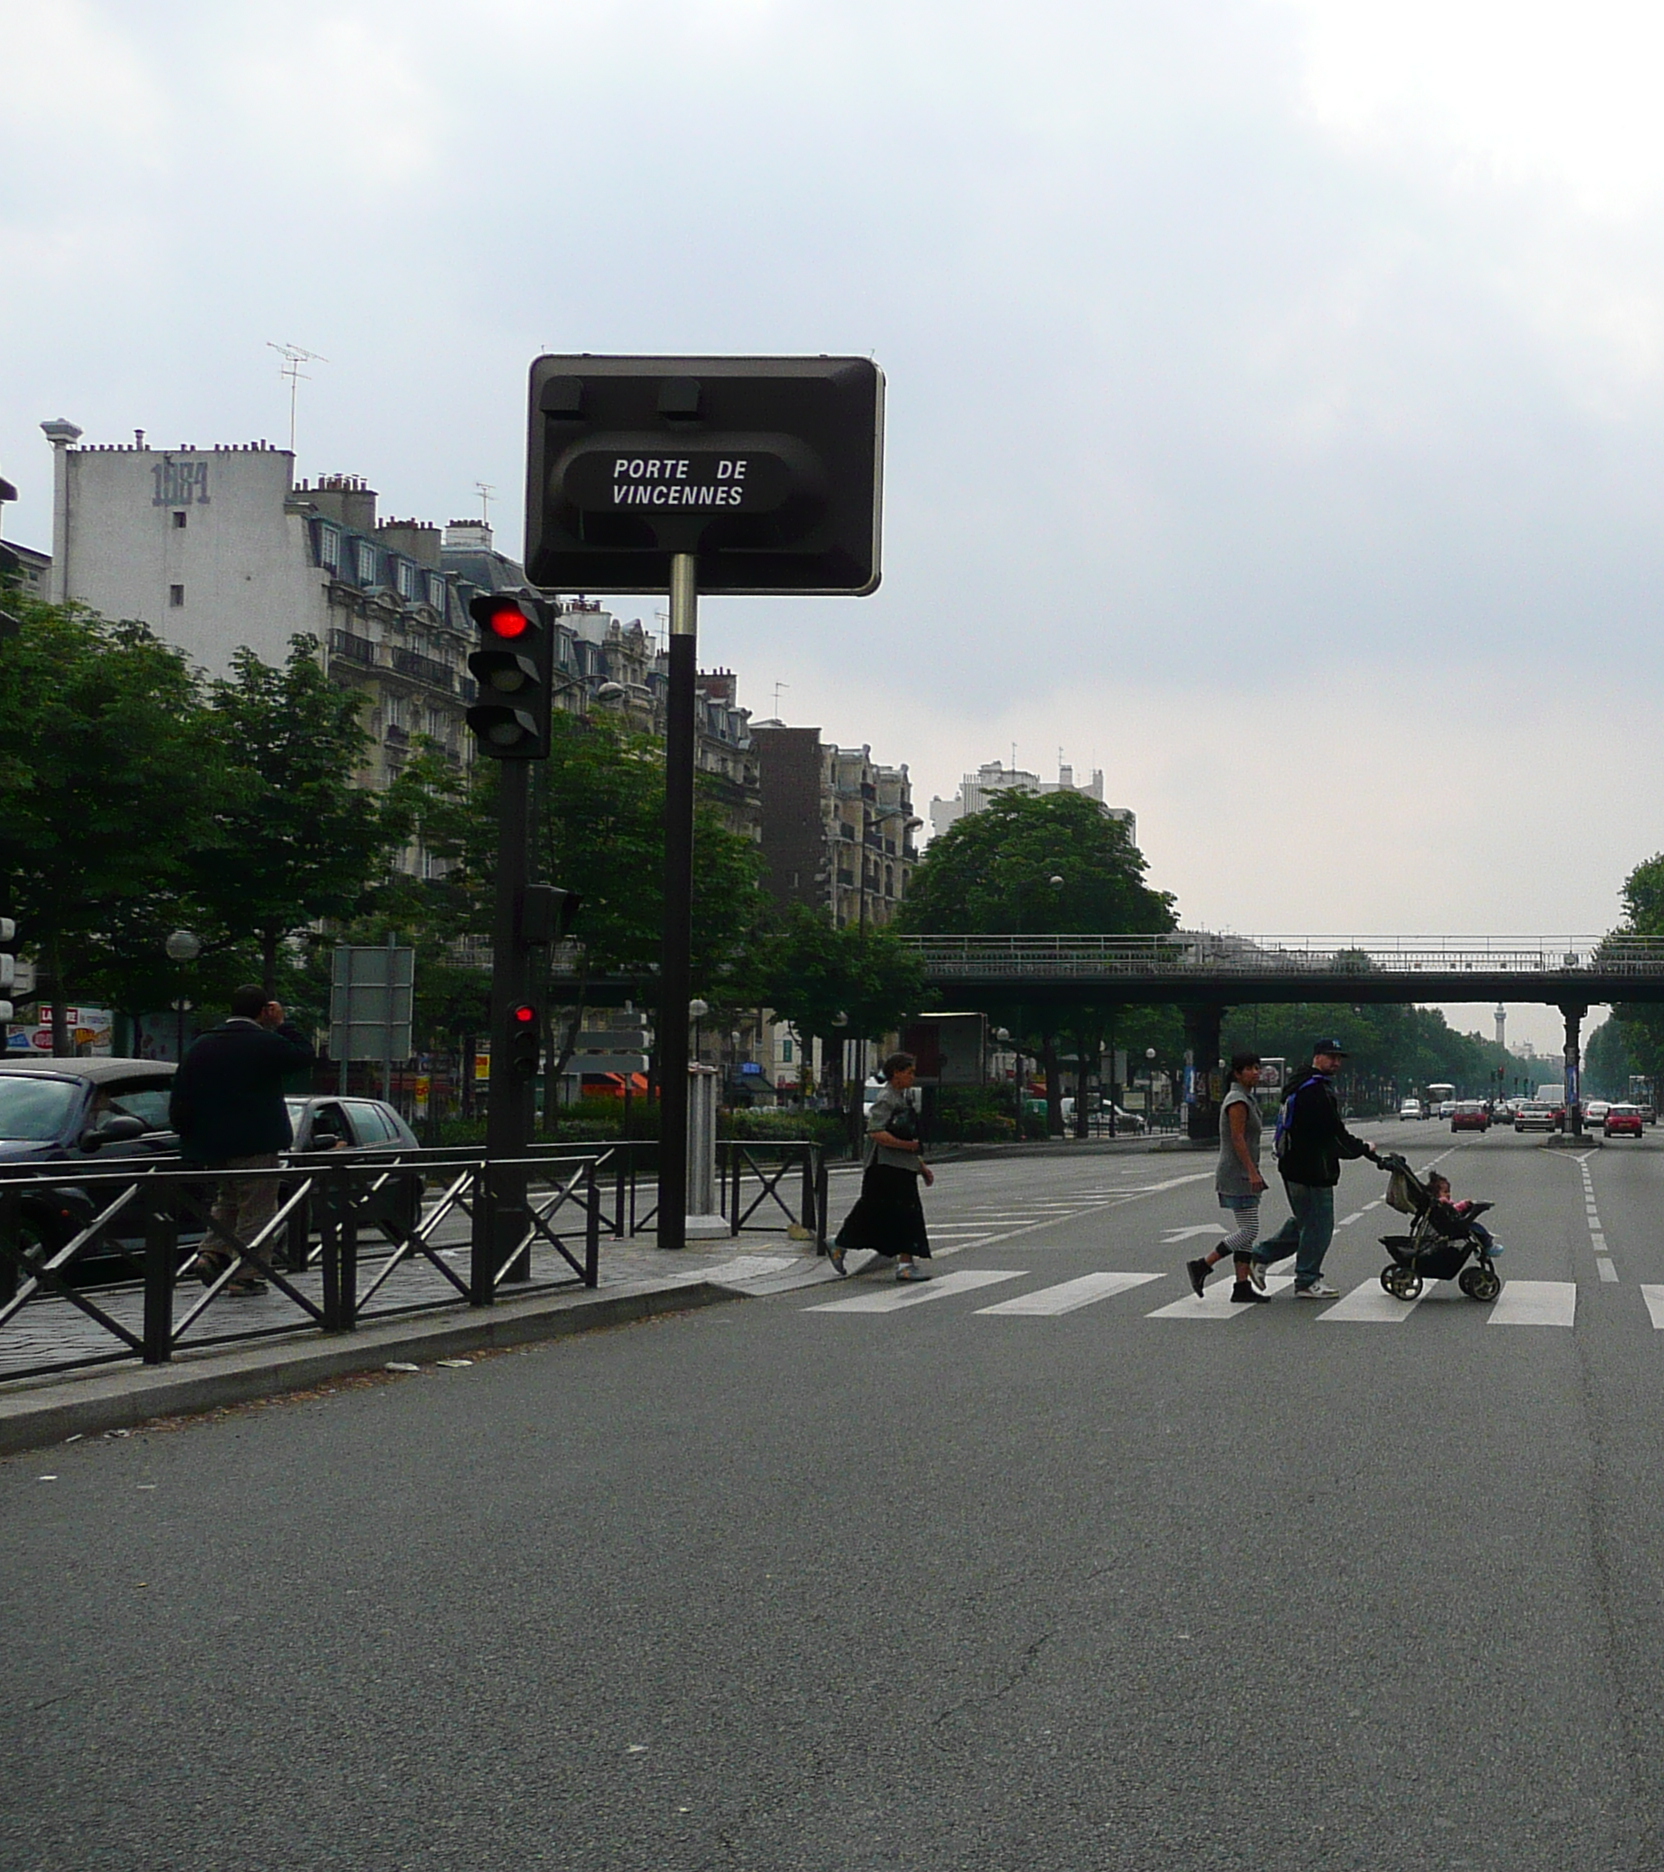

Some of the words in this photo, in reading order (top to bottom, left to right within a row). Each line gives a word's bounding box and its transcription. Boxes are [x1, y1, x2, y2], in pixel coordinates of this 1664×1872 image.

[613, 459, 690, 478] PORTE
[716, 460, 747, 479] DE
[613, 485, 743, 505] VINCENNES
